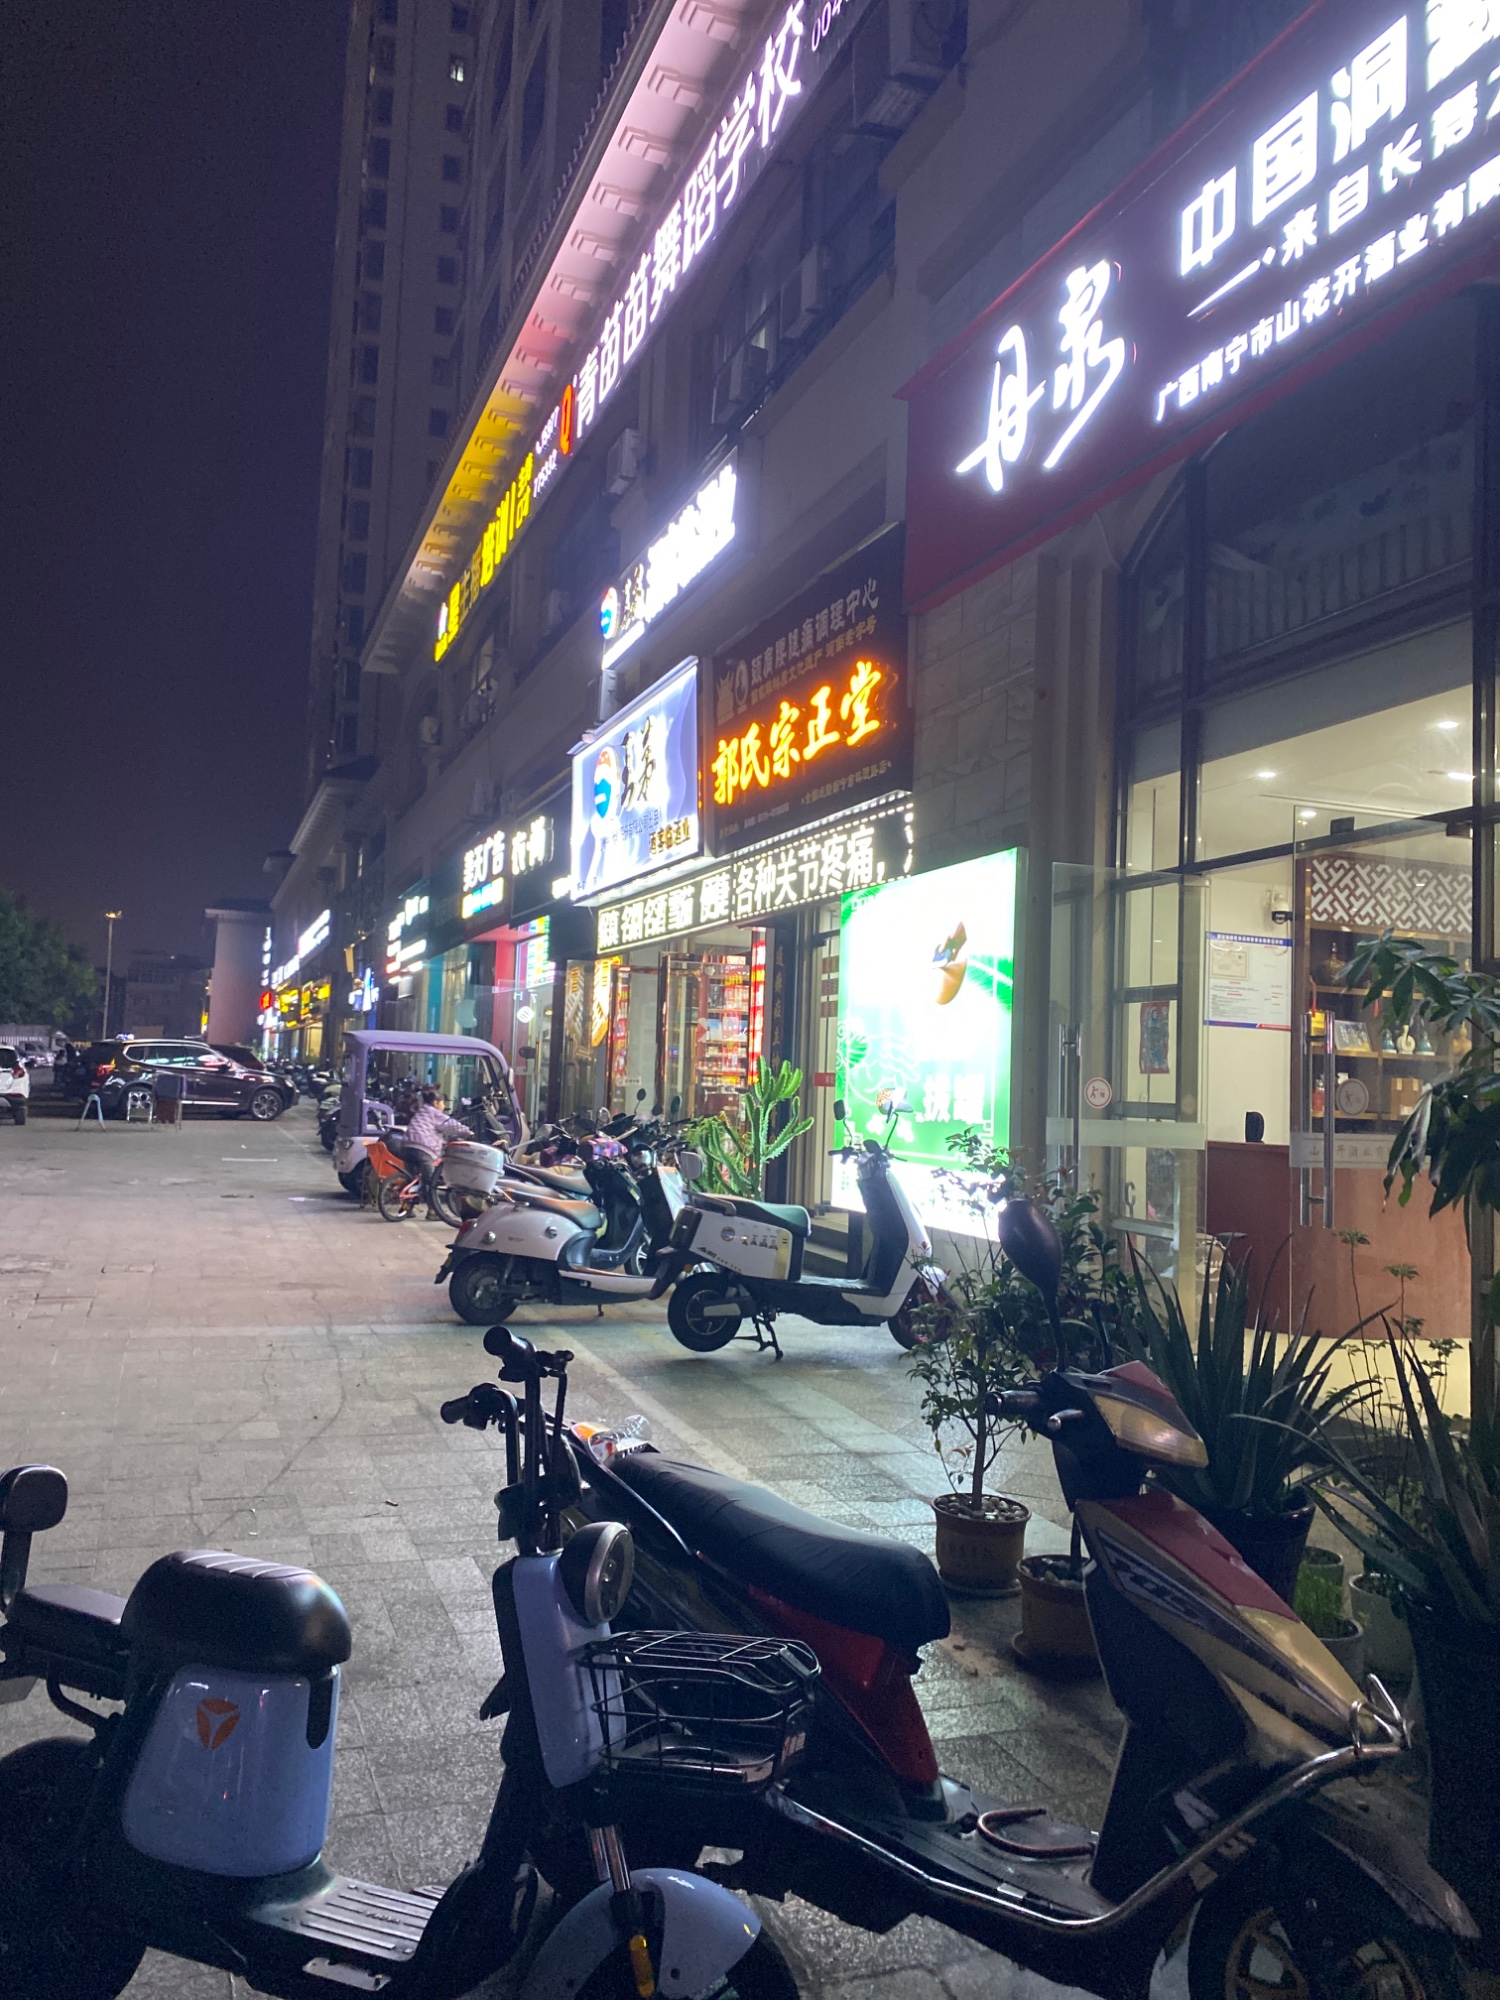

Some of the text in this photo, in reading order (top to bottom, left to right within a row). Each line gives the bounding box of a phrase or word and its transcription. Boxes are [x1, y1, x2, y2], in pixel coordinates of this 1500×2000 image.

[573, 0, 805, 440] 青苗苗舞蹈学校
[711, 658, 883, 806] 郭氏宗正堂
